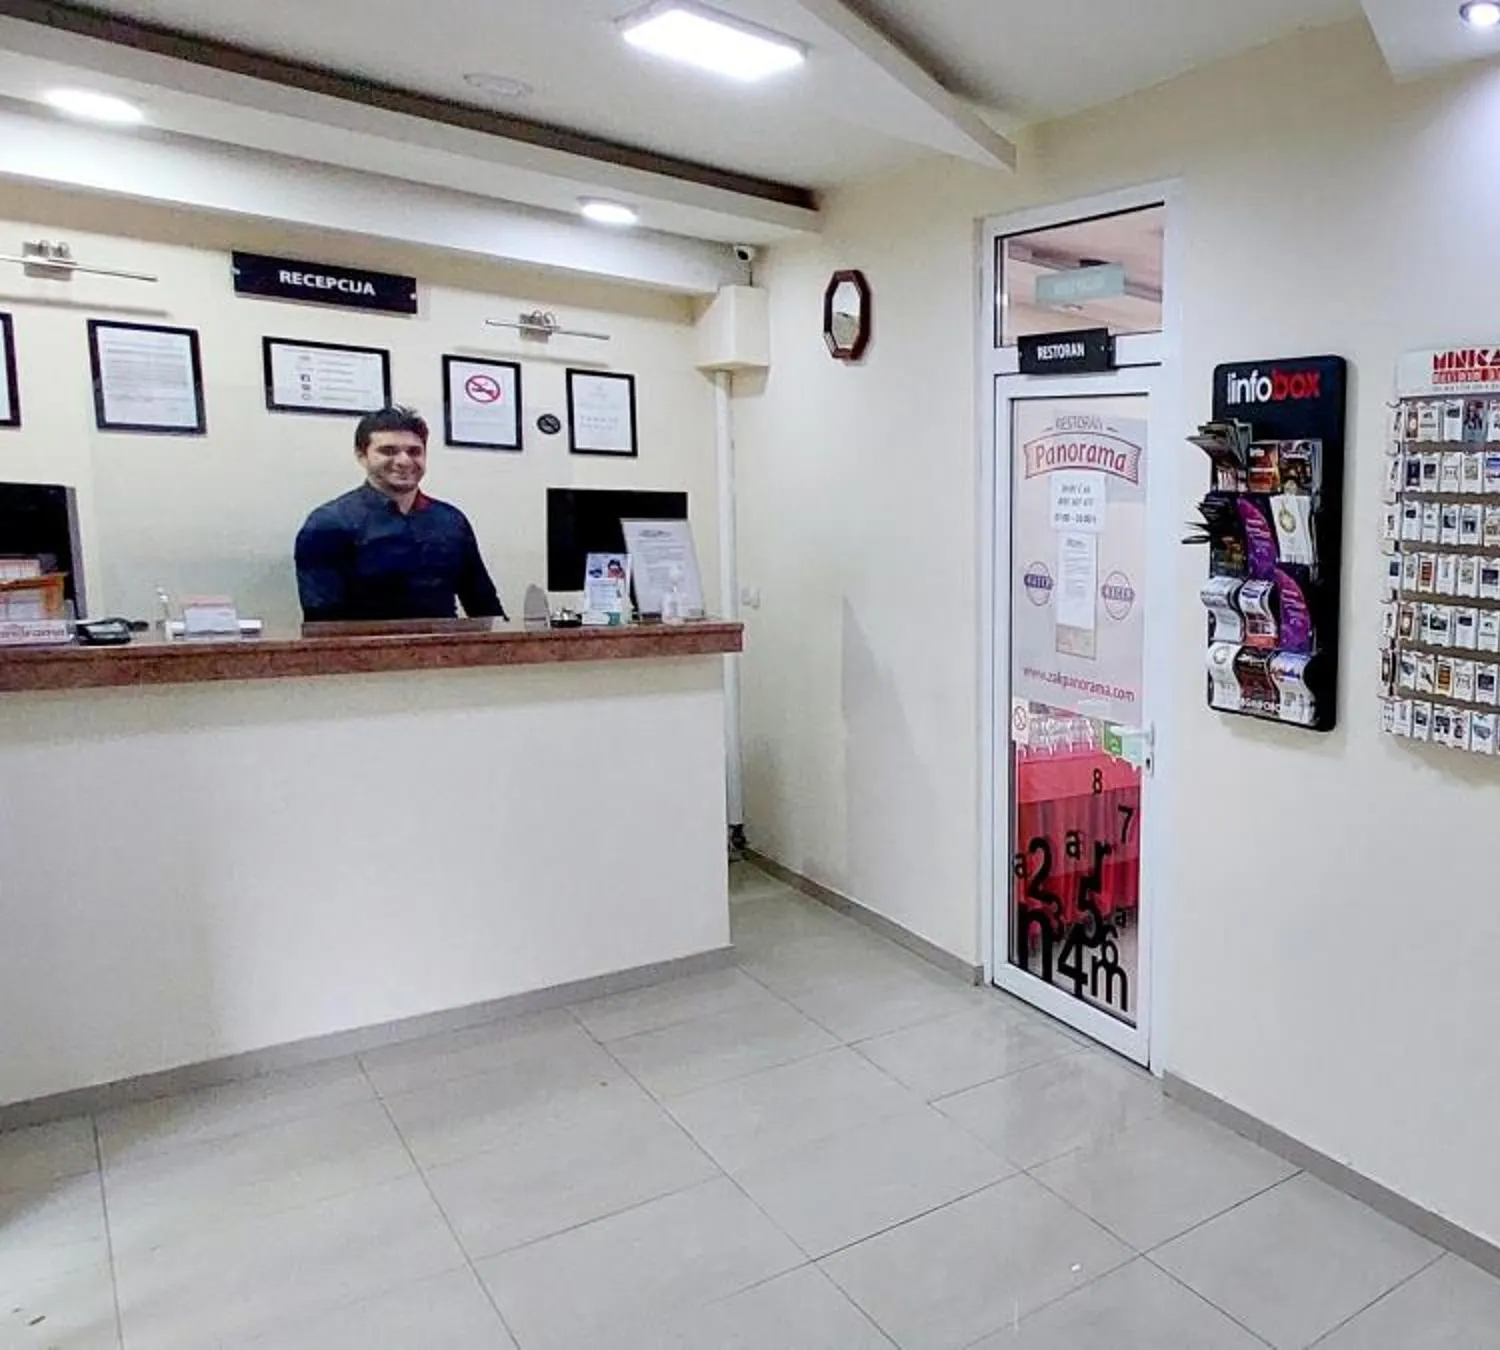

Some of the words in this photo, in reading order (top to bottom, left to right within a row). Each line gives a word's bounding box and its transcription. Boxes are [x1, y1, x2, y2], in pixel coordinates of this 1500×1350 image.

[278, 260, 376, 296] RECEPCIJA
[1036, 342, 1085, 361] RESTORAN
[1055, 415, 1103, 430] RESTORAN
[1036, 443, 1126, 471] Panorama
